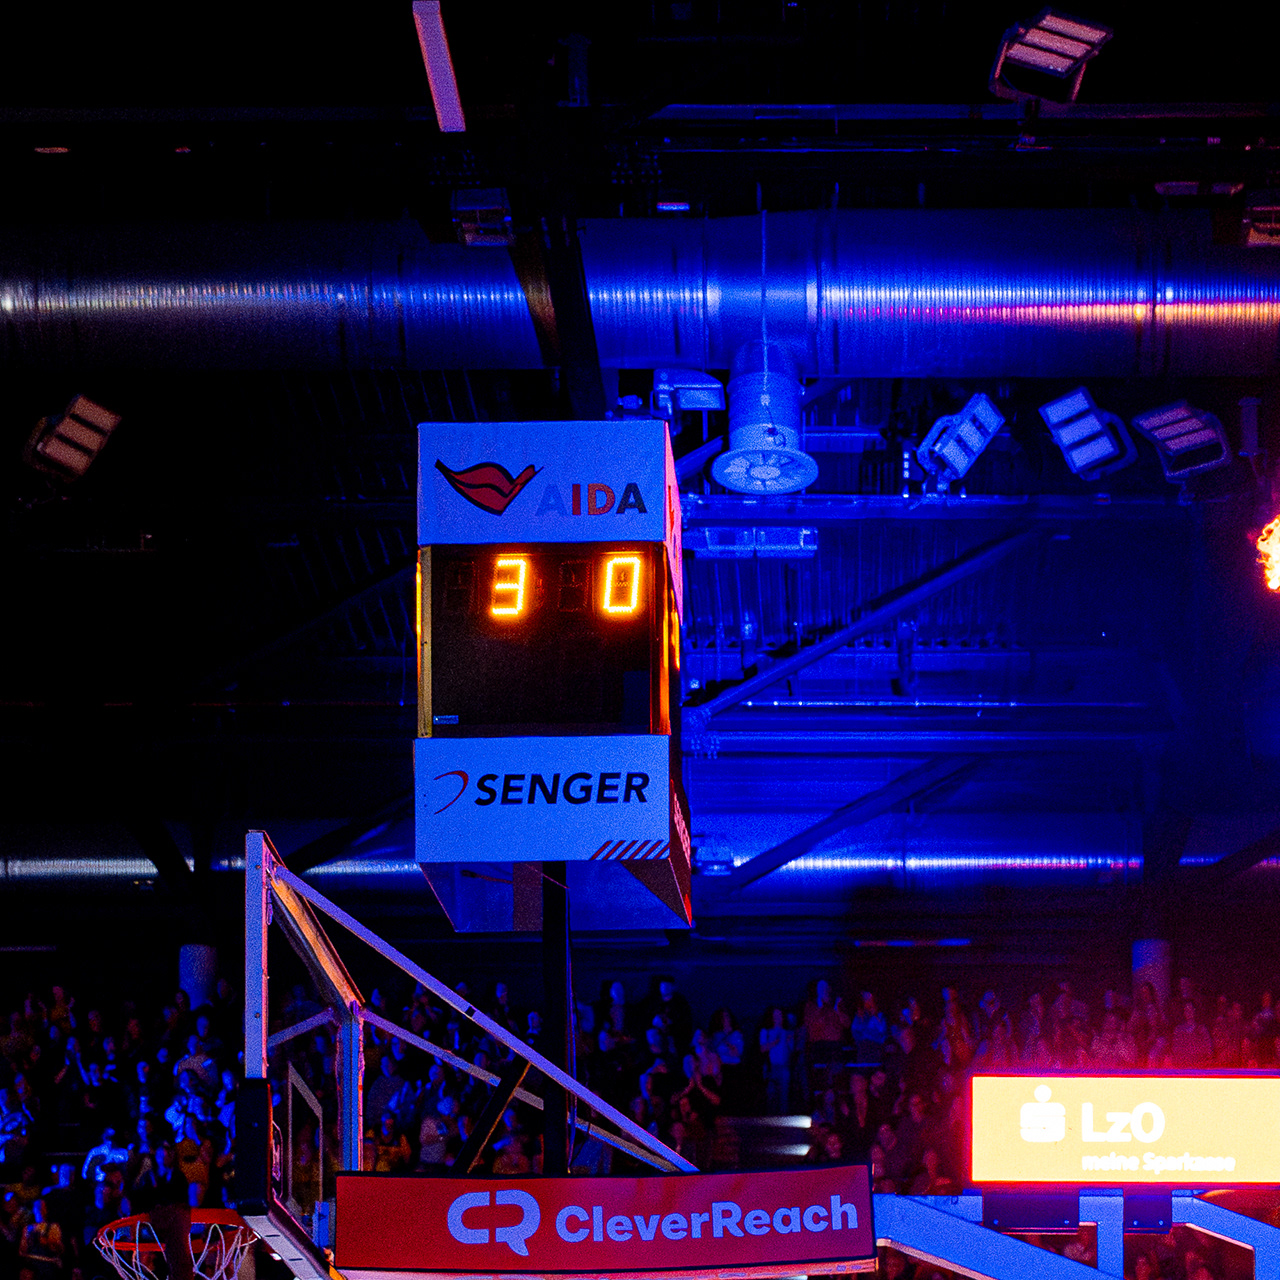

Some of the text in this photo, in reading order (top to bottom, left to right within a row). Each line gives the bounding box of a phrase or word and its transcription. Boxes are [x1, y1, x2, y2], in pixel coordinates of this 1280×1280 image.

[534, 483, 647, 516] AIDA
[491, 558, 527, 616] 3
[603, 556, 641, 614] 0
[474, 772, 651, 806] SENGER
[555, 1194, 859, 1244] CleverReach
